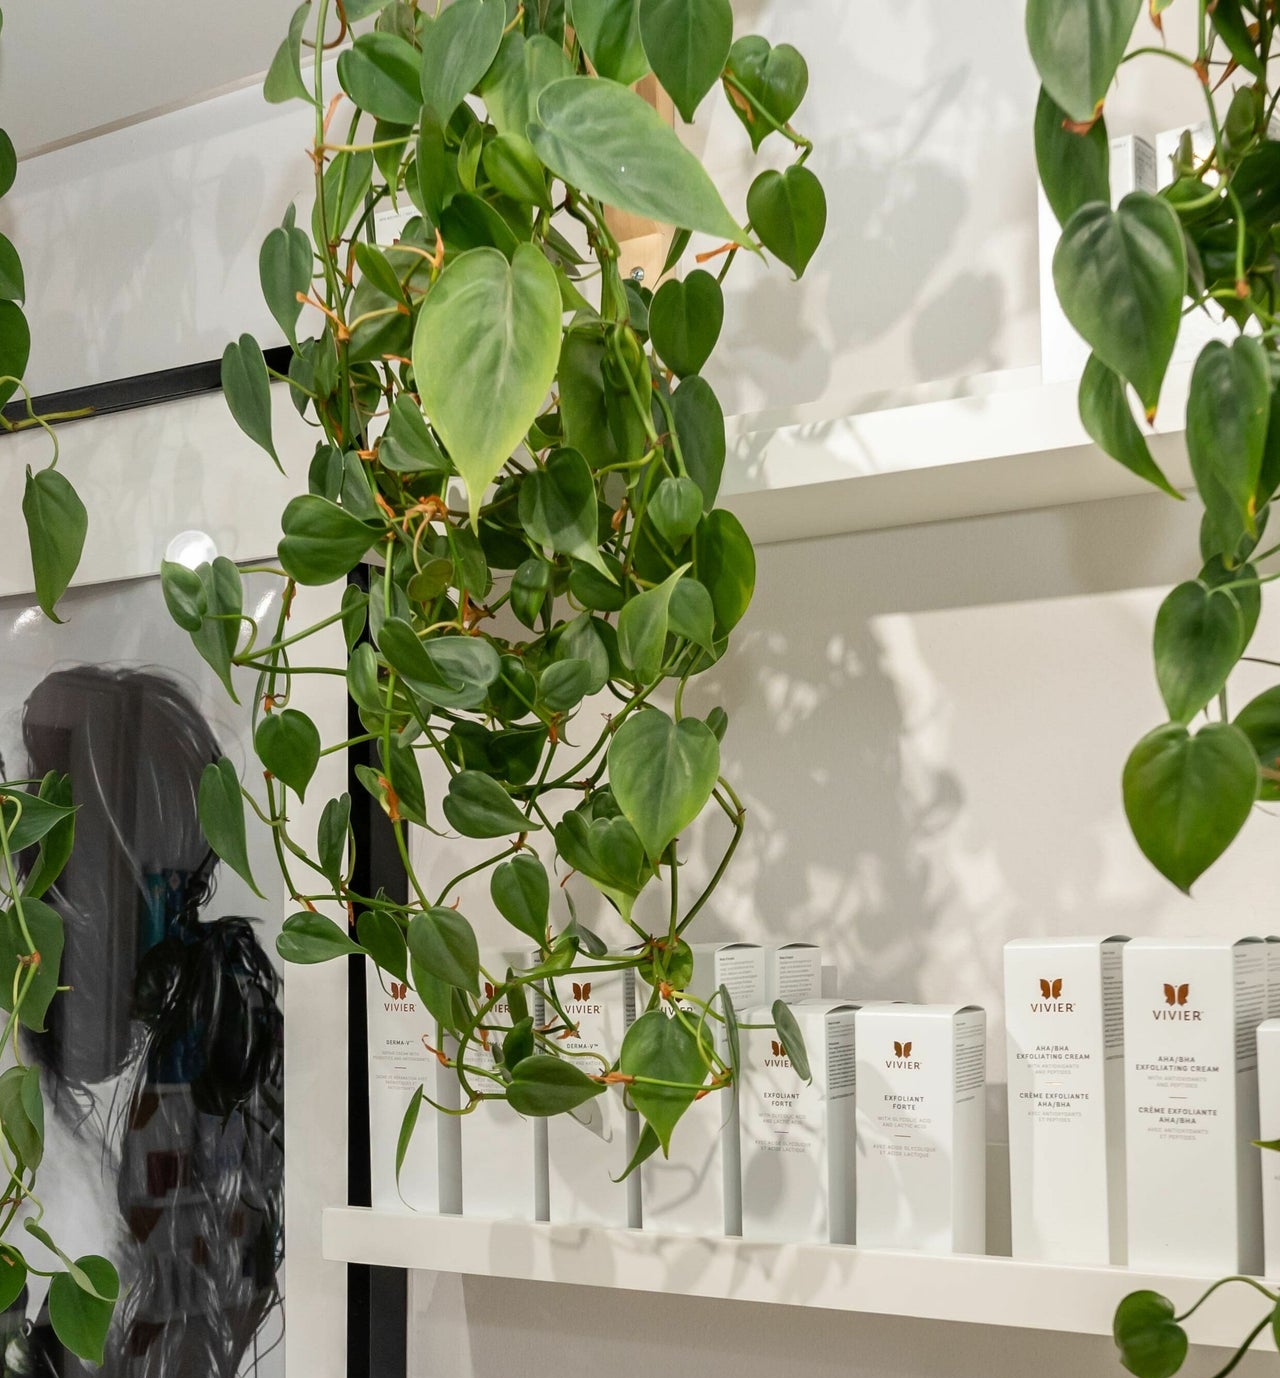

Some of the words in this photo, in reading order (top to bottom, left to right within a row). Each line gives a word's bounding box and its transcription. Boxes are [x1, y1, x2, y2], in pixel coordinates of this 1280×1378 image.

[384, 1003, 415, 1013] VIVIER
[565, 1005, 600, 1014] VIVIER
[1030, 1003, 1074, 1012] VIVIER
[1152, 1010, 1202, 1021] VIVIER
[885, 1061, 920, 1070] VIVIER
[1136, 1064, 1187, 1072] EXFOLIATING
[1190, 1065, 1219, 1073] CREAM
[1020, 1091, 1042, 1099] CRÈME
[1045, 1092, 1089, 1100] EXFOLIANTE
[1138, 1105, 1164, 1114] CRÈME
[1167, 1106, 1217, 1116] EXFOLIANTE
[1158, 1116, 1196, 1125] AHA/BHA
